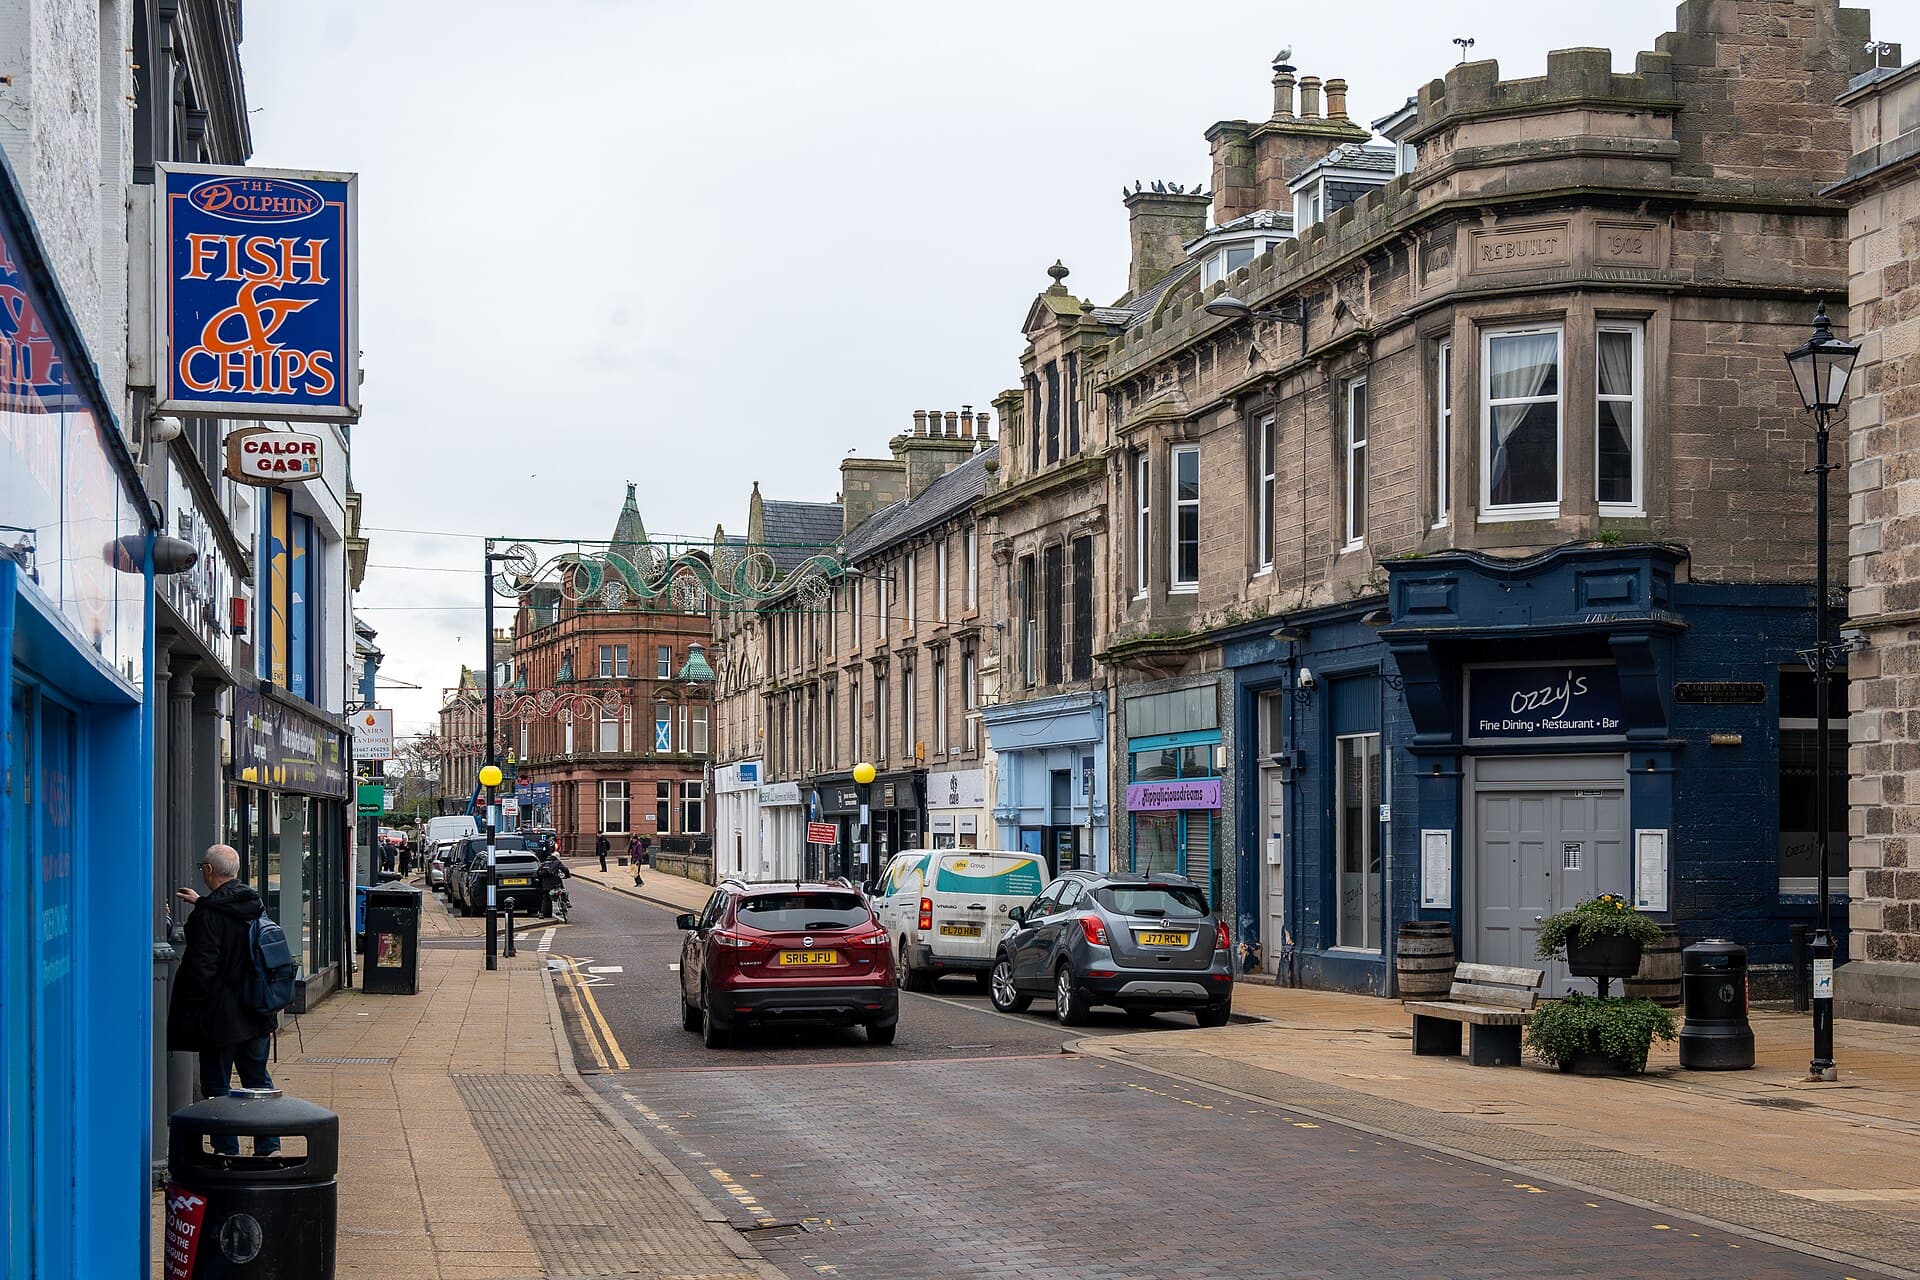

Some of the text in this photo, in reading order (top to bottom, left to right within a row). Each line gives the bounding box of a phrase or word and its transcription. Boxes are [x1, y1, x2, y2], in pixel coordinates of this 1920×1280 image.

[240, 181, 273, 191] THE
[1481, 237, 1558, 262] REBUILT
[1607, 235, 1643, 255] 1902
[180, 232, 331, 286] FISH
[201, 278, 320, 355] &
[179, 344, 335, 396] CHIPS
[243, 441, 317, 455] CALOR
[257, 458, 302, 473] GAS
[1479, 717, 1619, 732] Fine Dining Restaurant Bar
[970, 862, 986, 870] Group
[1145, 934, 1182, 944] J77 RCN
[785, 953, 831, 964] SR16 JFU
[175, 1218, 196, 1237] NOT
[177, 1236, 190, 1250] THE
